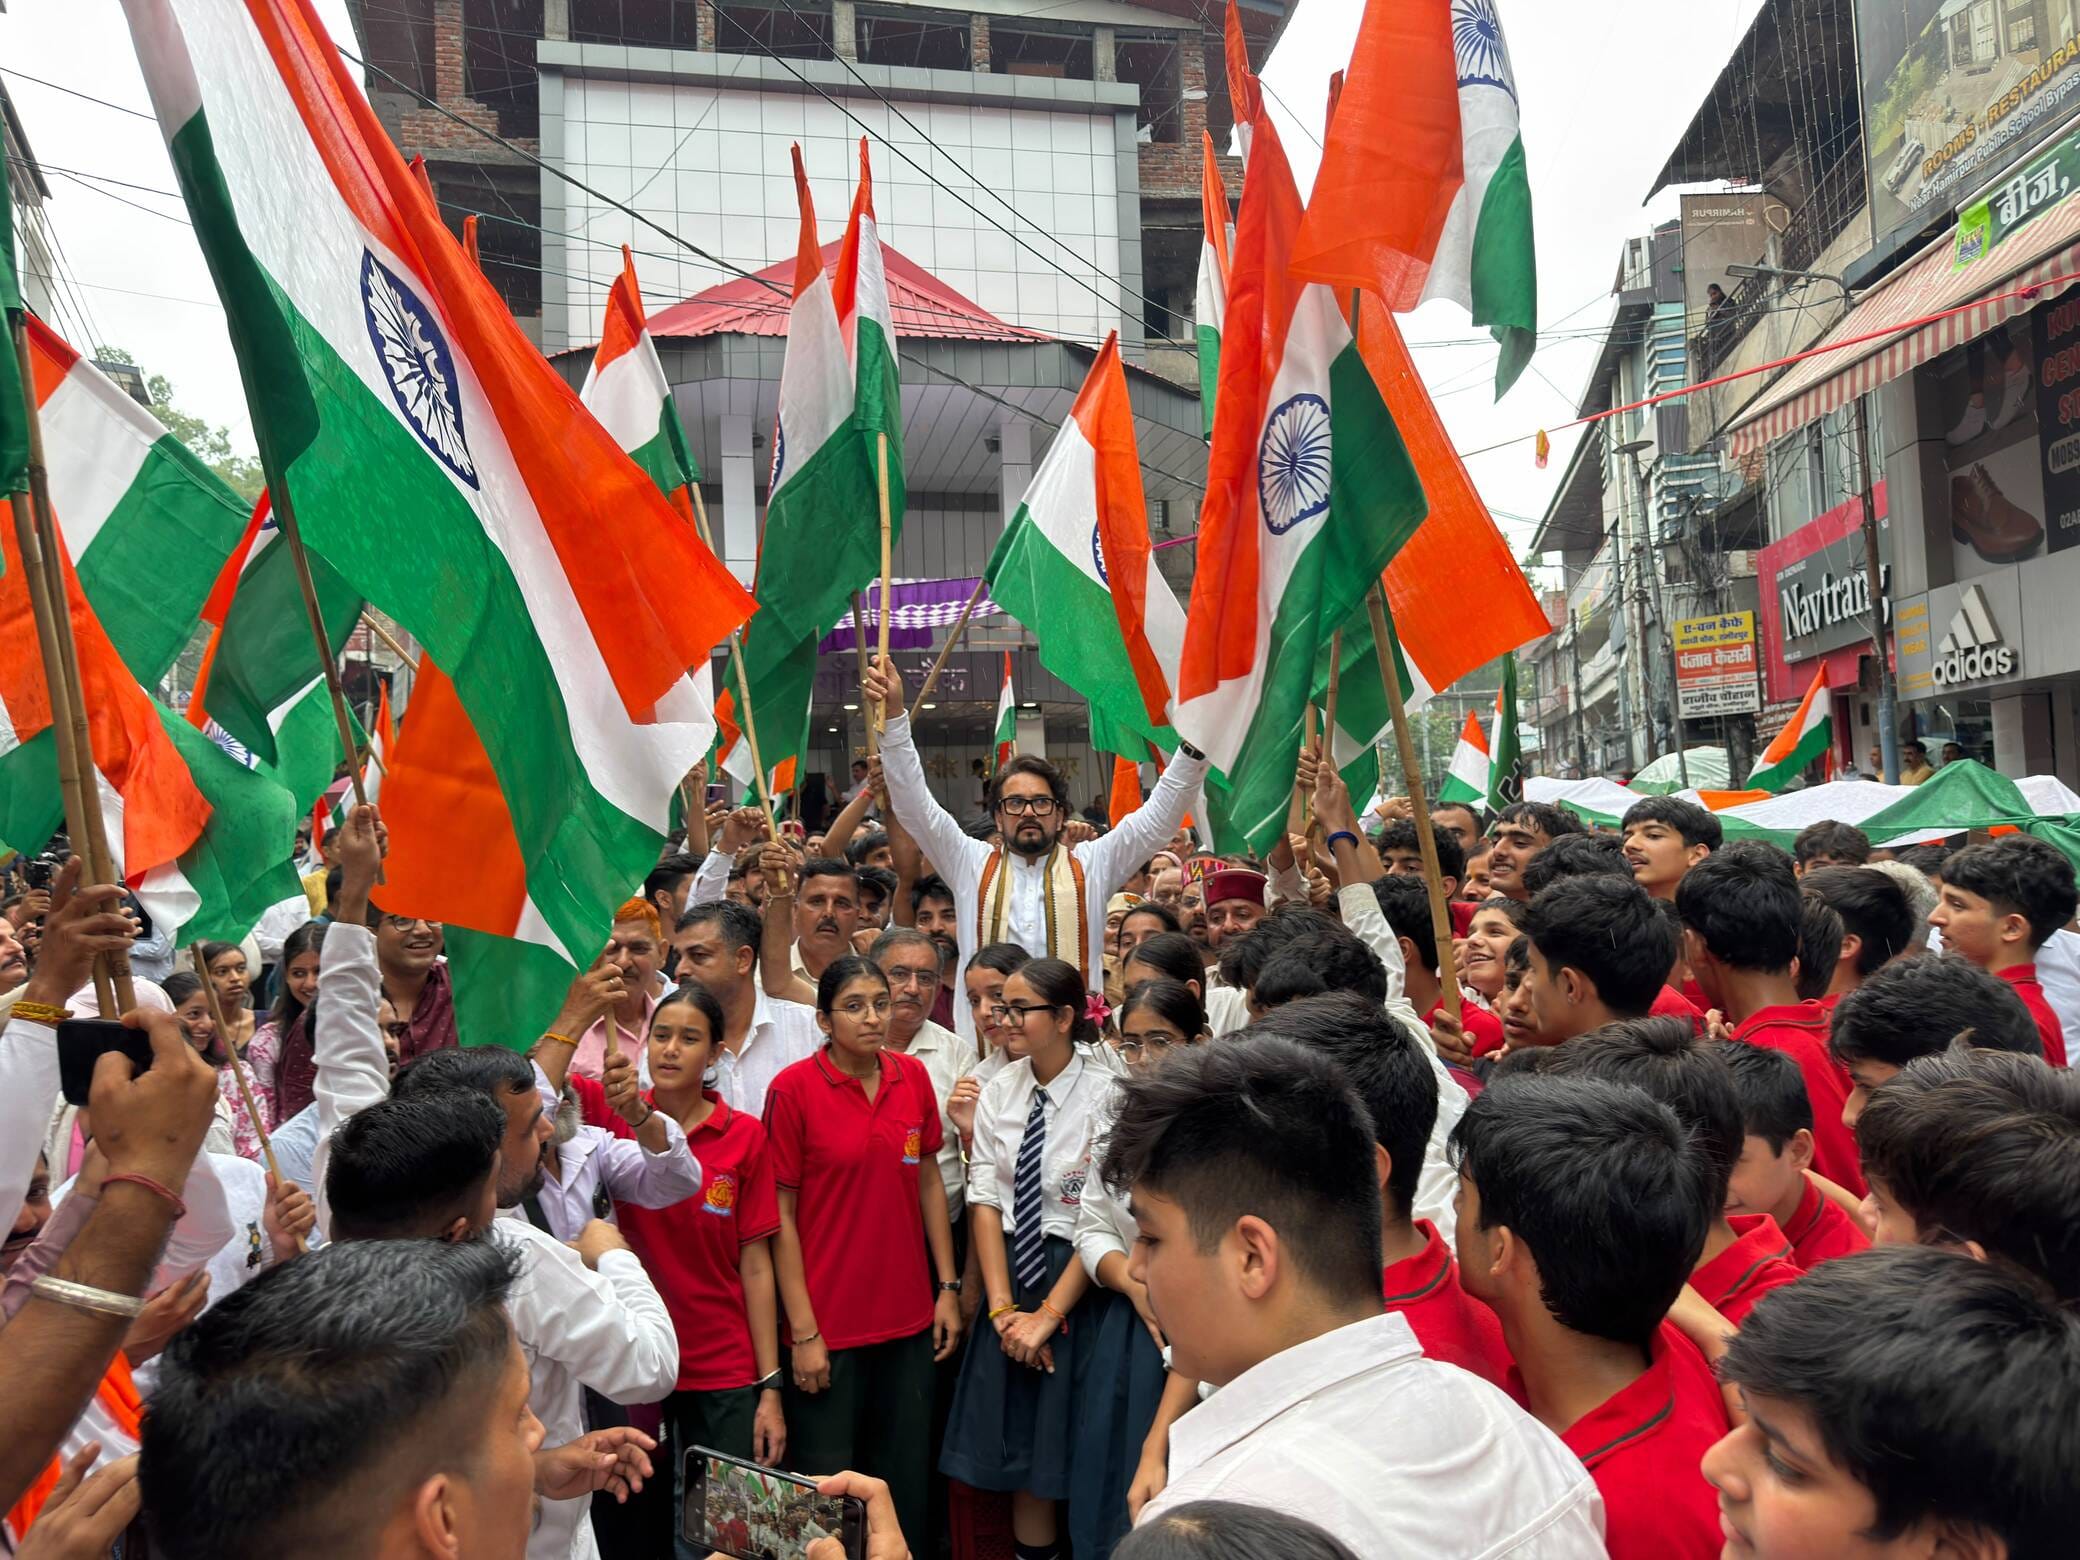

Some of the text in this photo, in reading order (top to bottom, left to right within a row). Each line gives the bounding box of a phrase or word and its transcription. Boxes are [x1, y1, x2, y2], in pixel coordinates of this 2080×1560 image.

[1922, 33, 2080, 179] ROOMS RESTAURA
[1910, 72, 2080, 213] Near Hamirpur Public School Bypas
[1995, 158, 2070, 225] बीज,
[1679, 644, 1752, 669] पंजाब केसरी
[1933, 645, 2013, 686] adidas
[1681, 692, 1717, 705] राजीव
[1719, 689, 1756, 701] चौहान
